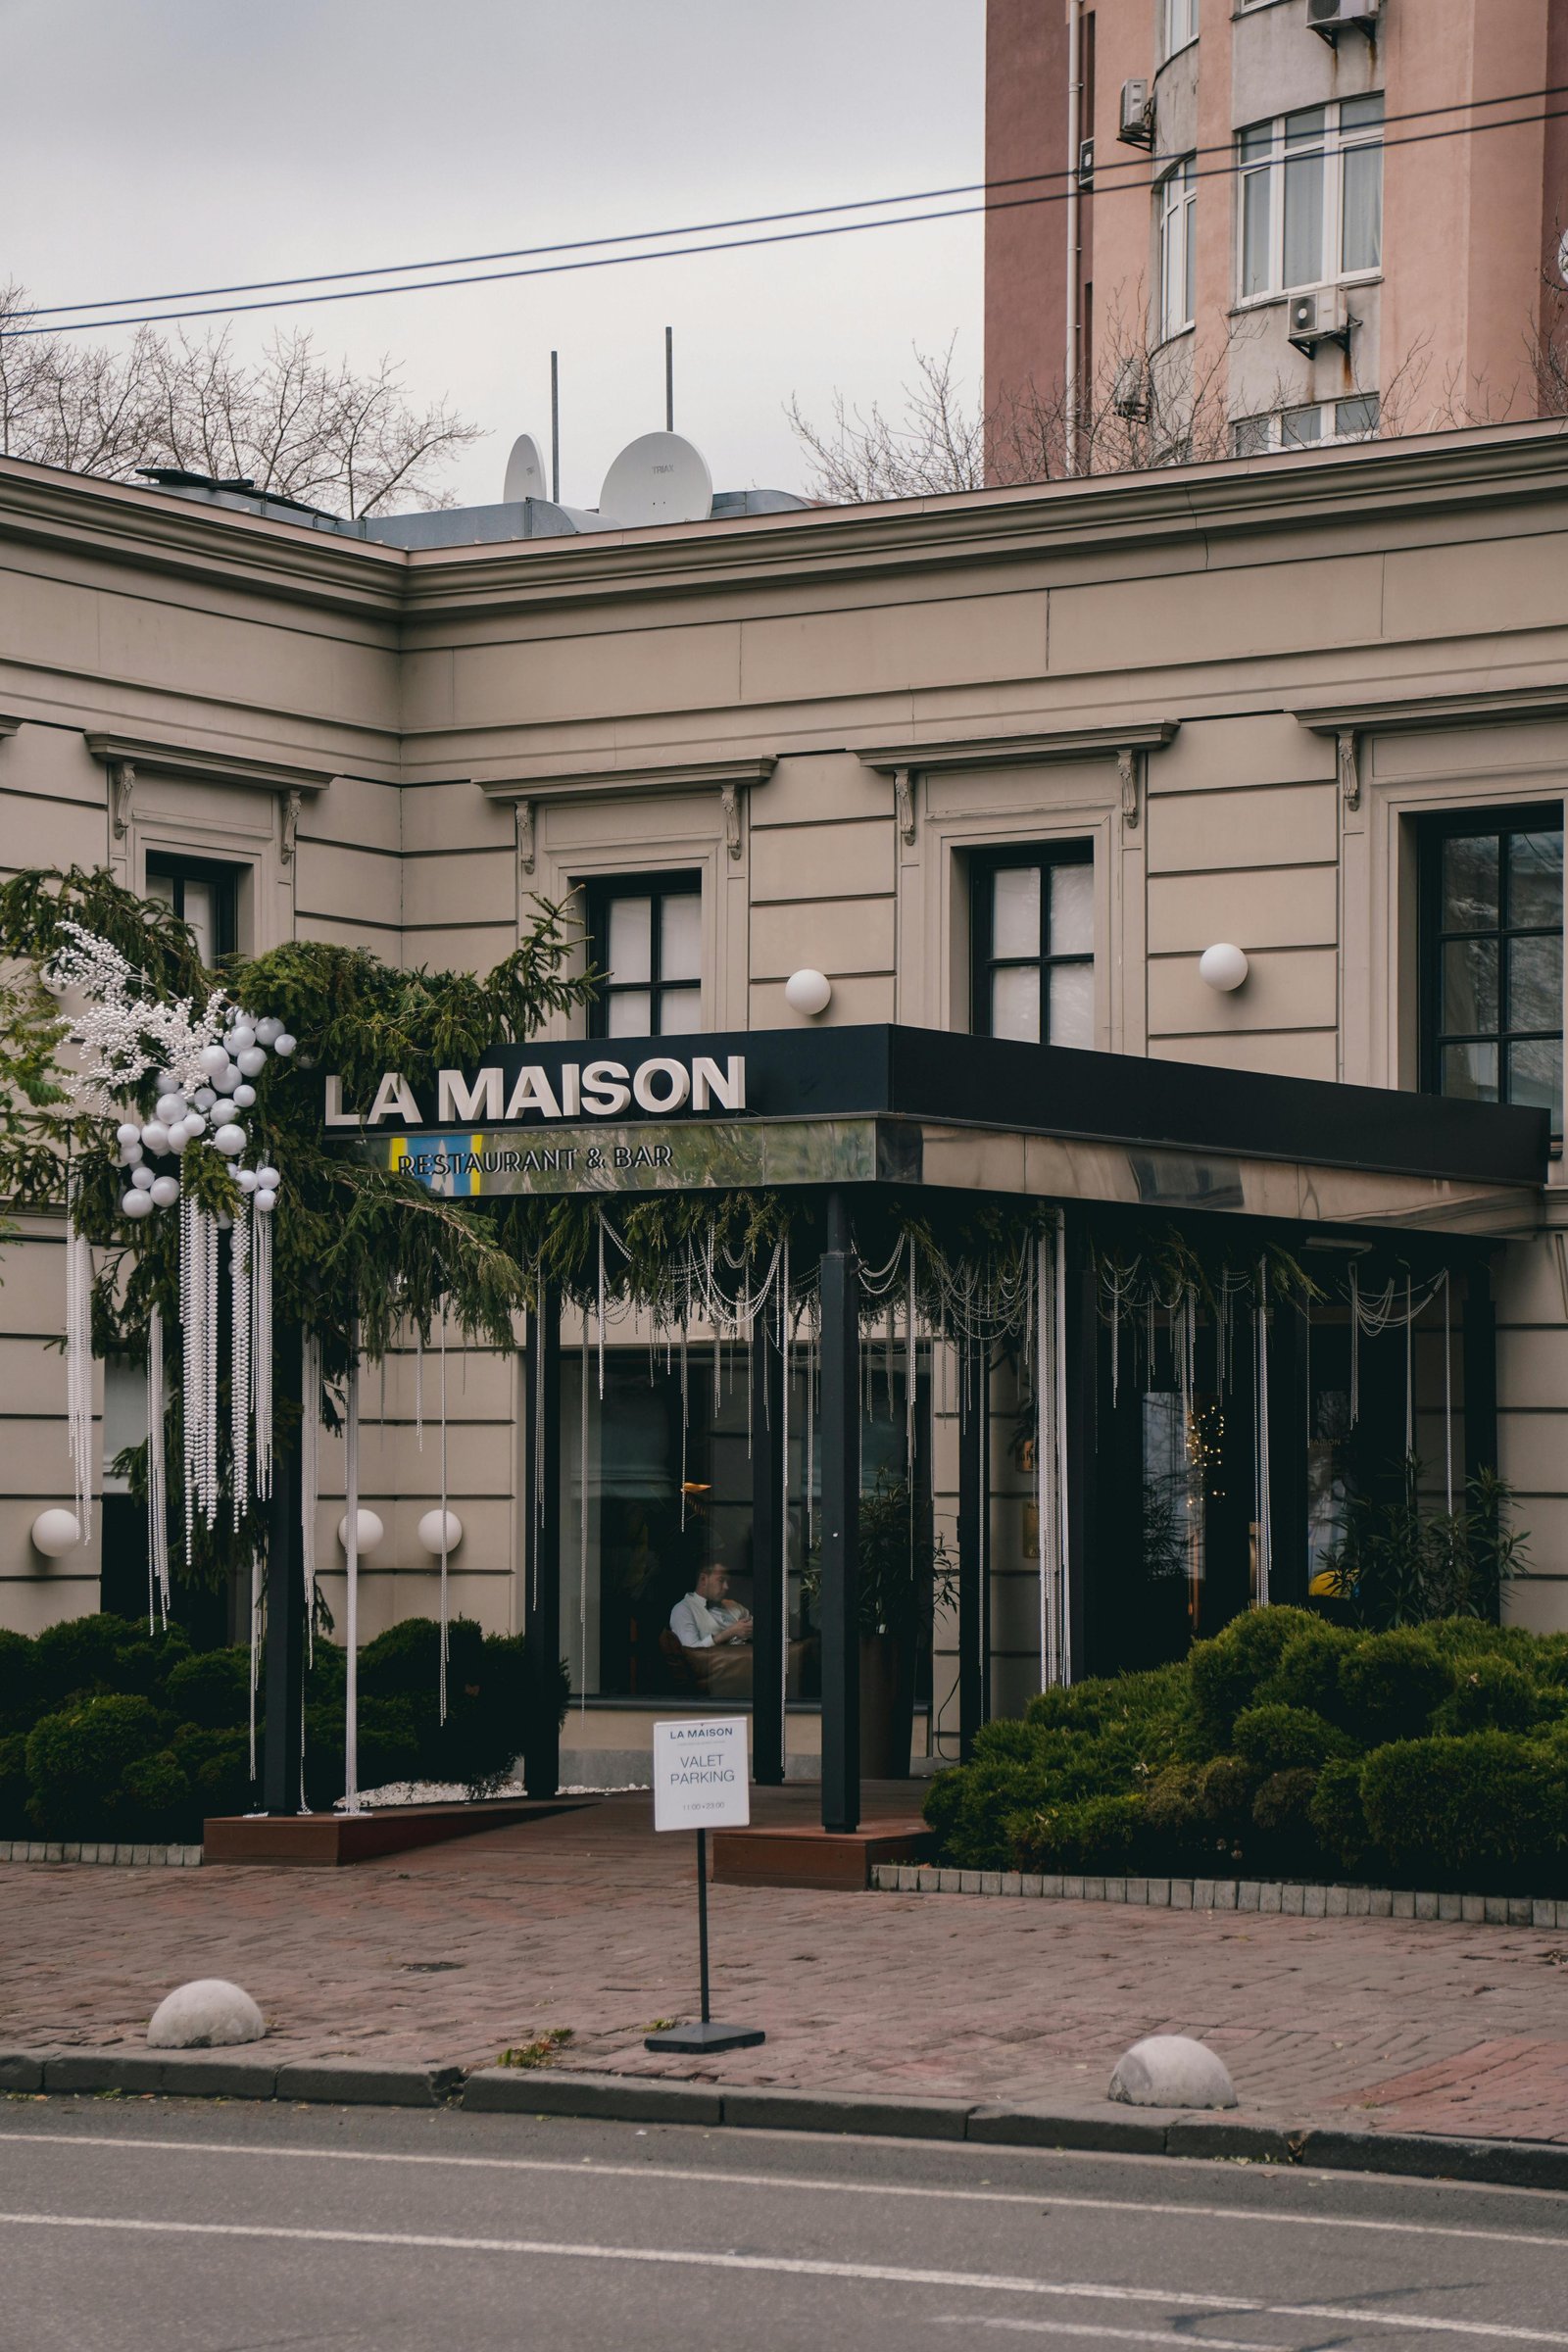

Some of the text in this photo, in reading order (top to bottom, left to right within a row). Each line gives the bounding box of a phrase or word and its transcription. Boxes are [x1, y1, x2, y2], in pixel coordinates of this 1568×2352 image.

[651, 464, 675, 475] TRIAX
[324, 1055, 746, 1126] LA MAISON
[398, 1145, 673, 1176] RESTAURANT & BAR
[670, 1728, 733, 1740] LA MAISON
[680, 1753, 724, 1769] VALET
[670, 1769, 735, 1785] PARKING
